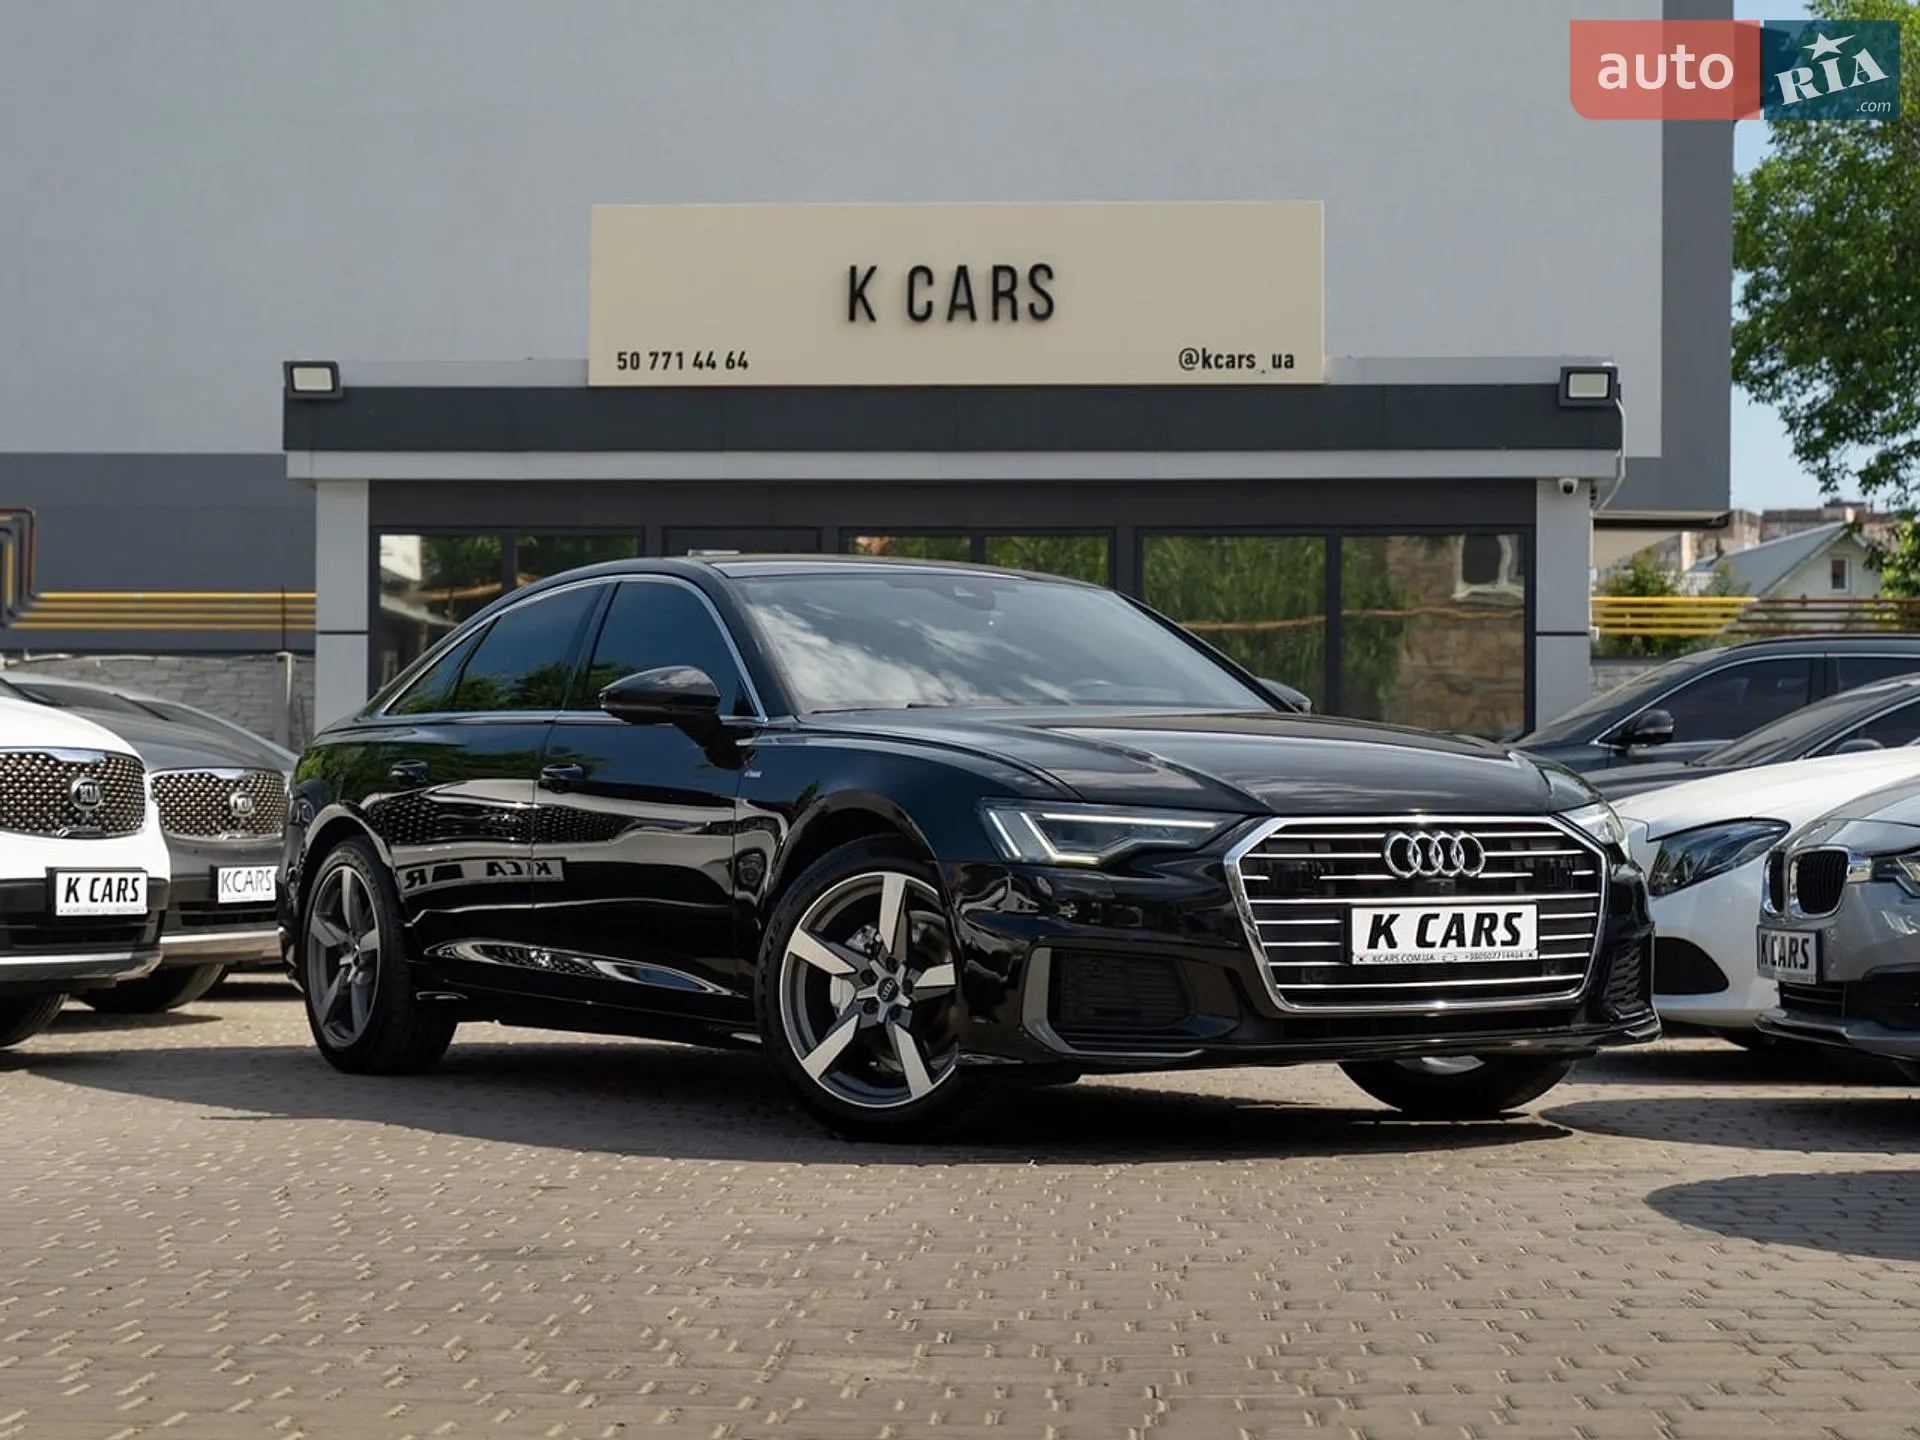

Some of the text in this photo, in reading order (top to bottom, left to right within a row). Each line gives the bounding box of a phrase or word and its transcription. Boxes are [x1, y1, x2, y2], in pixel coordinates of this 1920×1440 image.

[846, 262, 1057, 323] K CARS
[617, 351, 749, 371] 50 771 44 64
[65, 877, 140, 903] K CARS
[1366, 912, 1523, 949] K CARS
[1770, 935, 1810, 969] CARS
